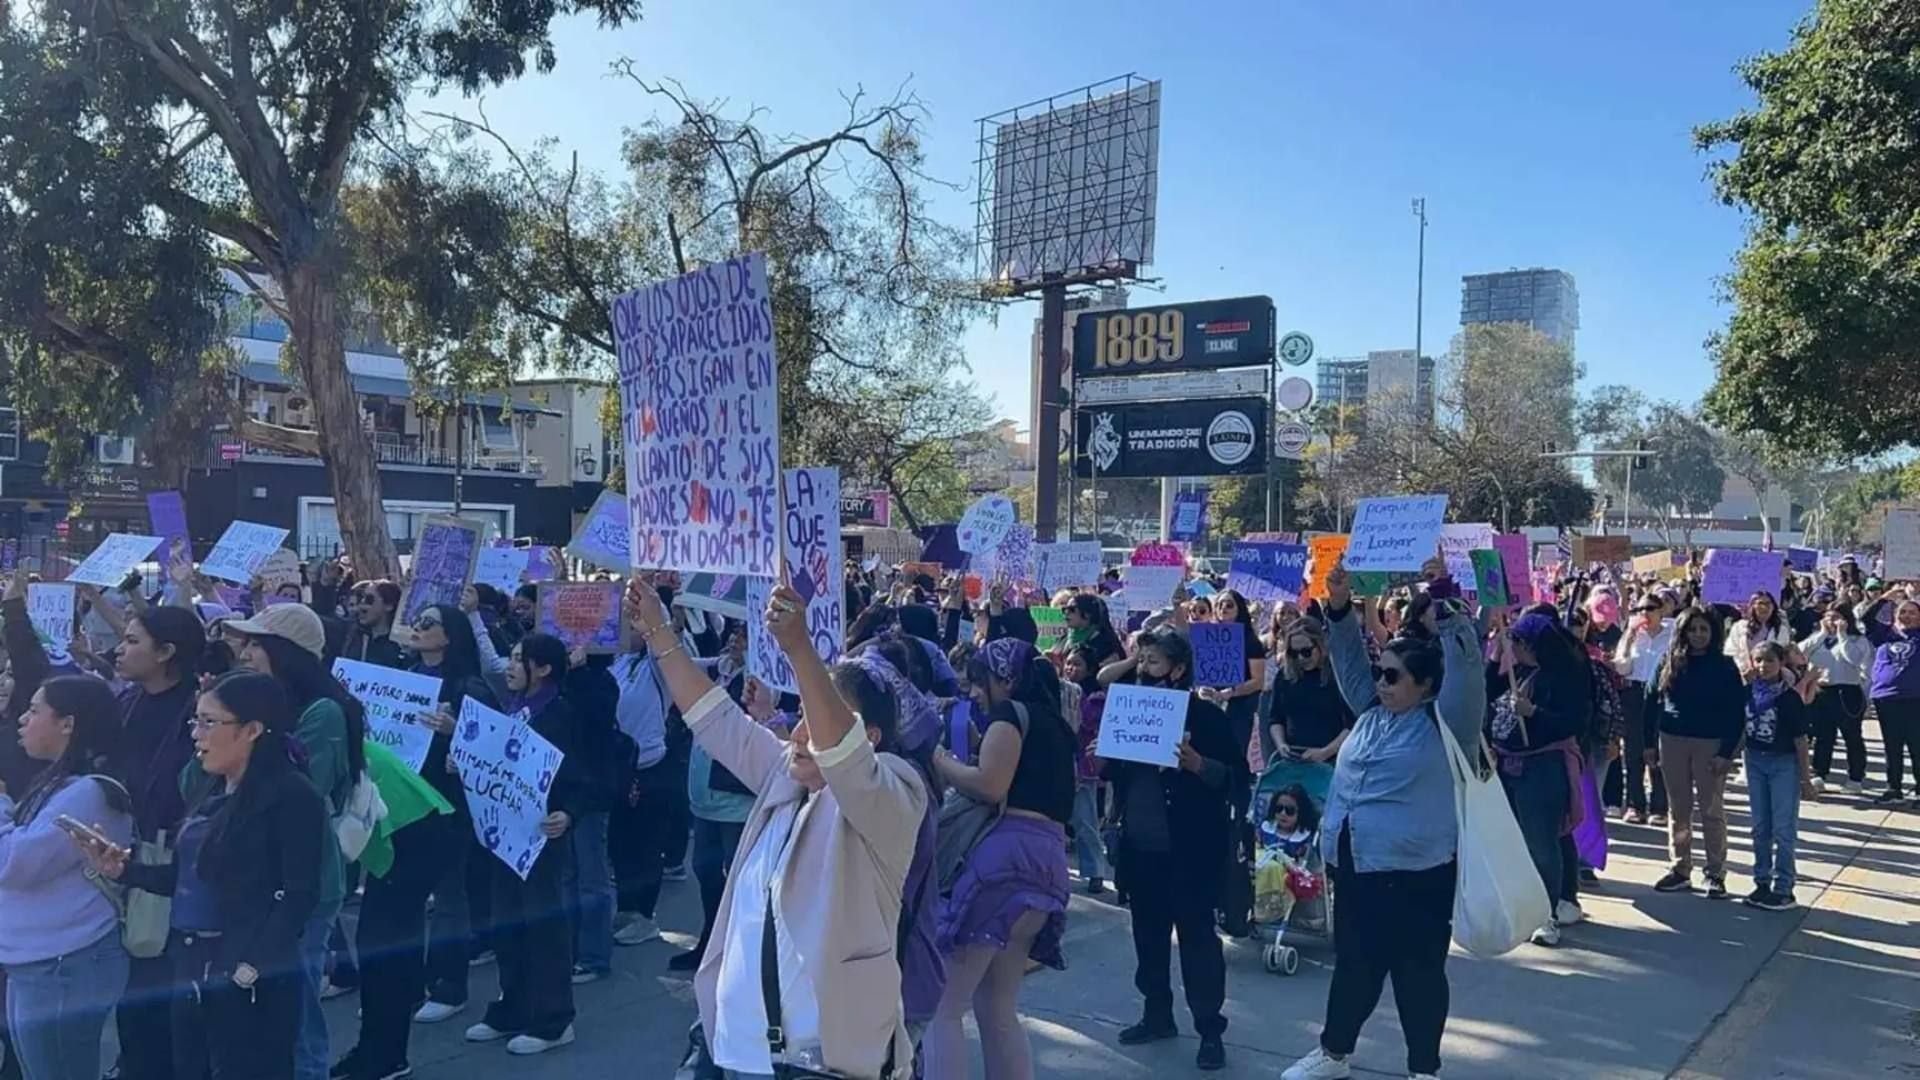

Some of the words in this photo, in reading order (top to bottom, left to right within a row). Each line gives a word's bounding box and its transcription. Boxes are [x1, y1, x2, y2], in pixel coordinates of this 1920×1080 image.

[613, 290, 642, 342] QUE
[647, 282, 675, 329] LOS
[677, 266, 721, 321] OJOS
[726, 256, 757, 302] DE
[617, 340, 643, 378] LOS
[644, 297, 773, 367] DESAPARECIDAS
[1093, 309, 1184, 369] 1889
[622, 375, 641, 409] TE
[649, 354, 736, 402] PERSIGAN
[744, 348, 772, 391] EN
[738, 393, 761, 435] EL
[703, 437, 727, 481] DE
[738, 436, 775, 486] SUS
[630, 483, 691, 528] MADRES
[706, 487, 736, 527] NO
[747, 486, 776, 534] TE
[783, 469, 815, 510] LA
[840, 499, 866, 512] TORY
[637, 527, 691, 567] DEJEN
[697, 527, 775, 575] DORMIR
[786, 510, 827, 548] QUE
[1205, 627, 1232, 643] NO
[462, 768, 523, 816] LUCHAR
